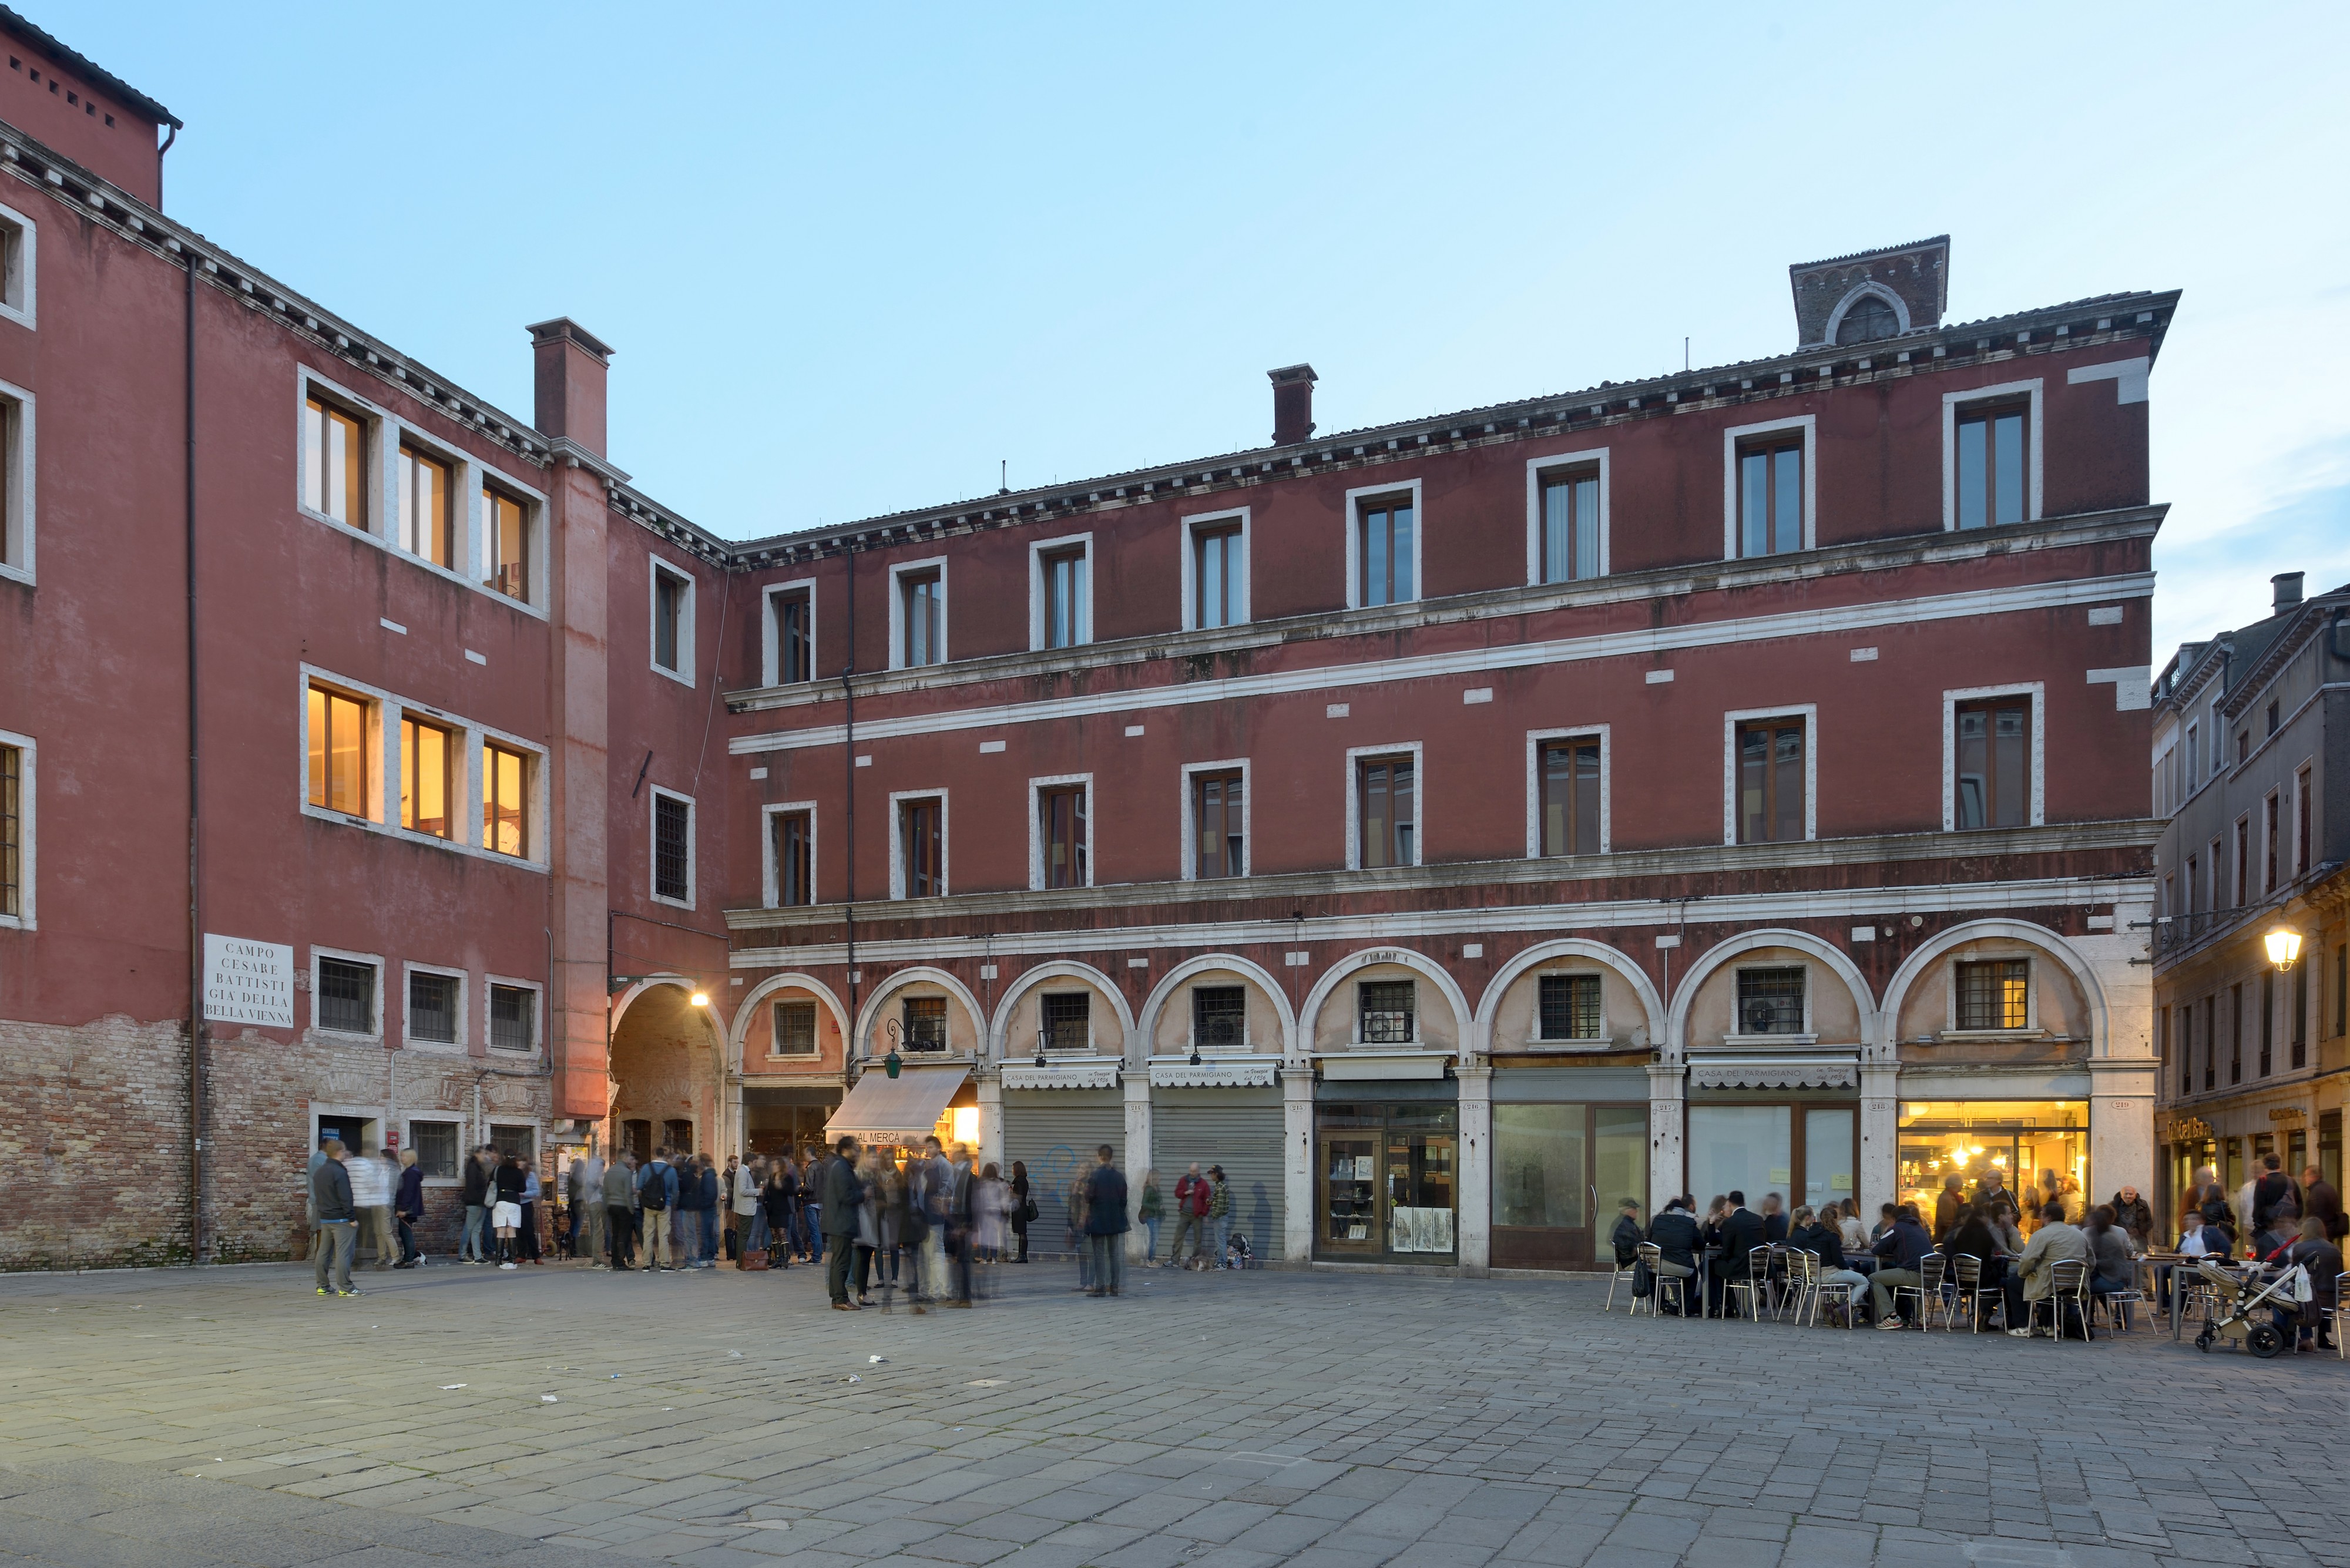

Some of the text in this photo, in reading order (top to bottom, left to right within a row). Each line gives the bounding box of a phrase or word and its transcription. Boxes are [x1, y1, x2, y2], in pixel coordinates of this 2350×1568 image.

[226, 943, 274, 959] CAMPO
[221, 958, 278, 975] CESARE
[216, 973, 284, 991] BATTISTI
[242, 992, 288, 1008] DELLA
[206, 1004, 291, 1023] BELLA VIENNA
[857, 1131, 900, 1143] AL MERCÀ
